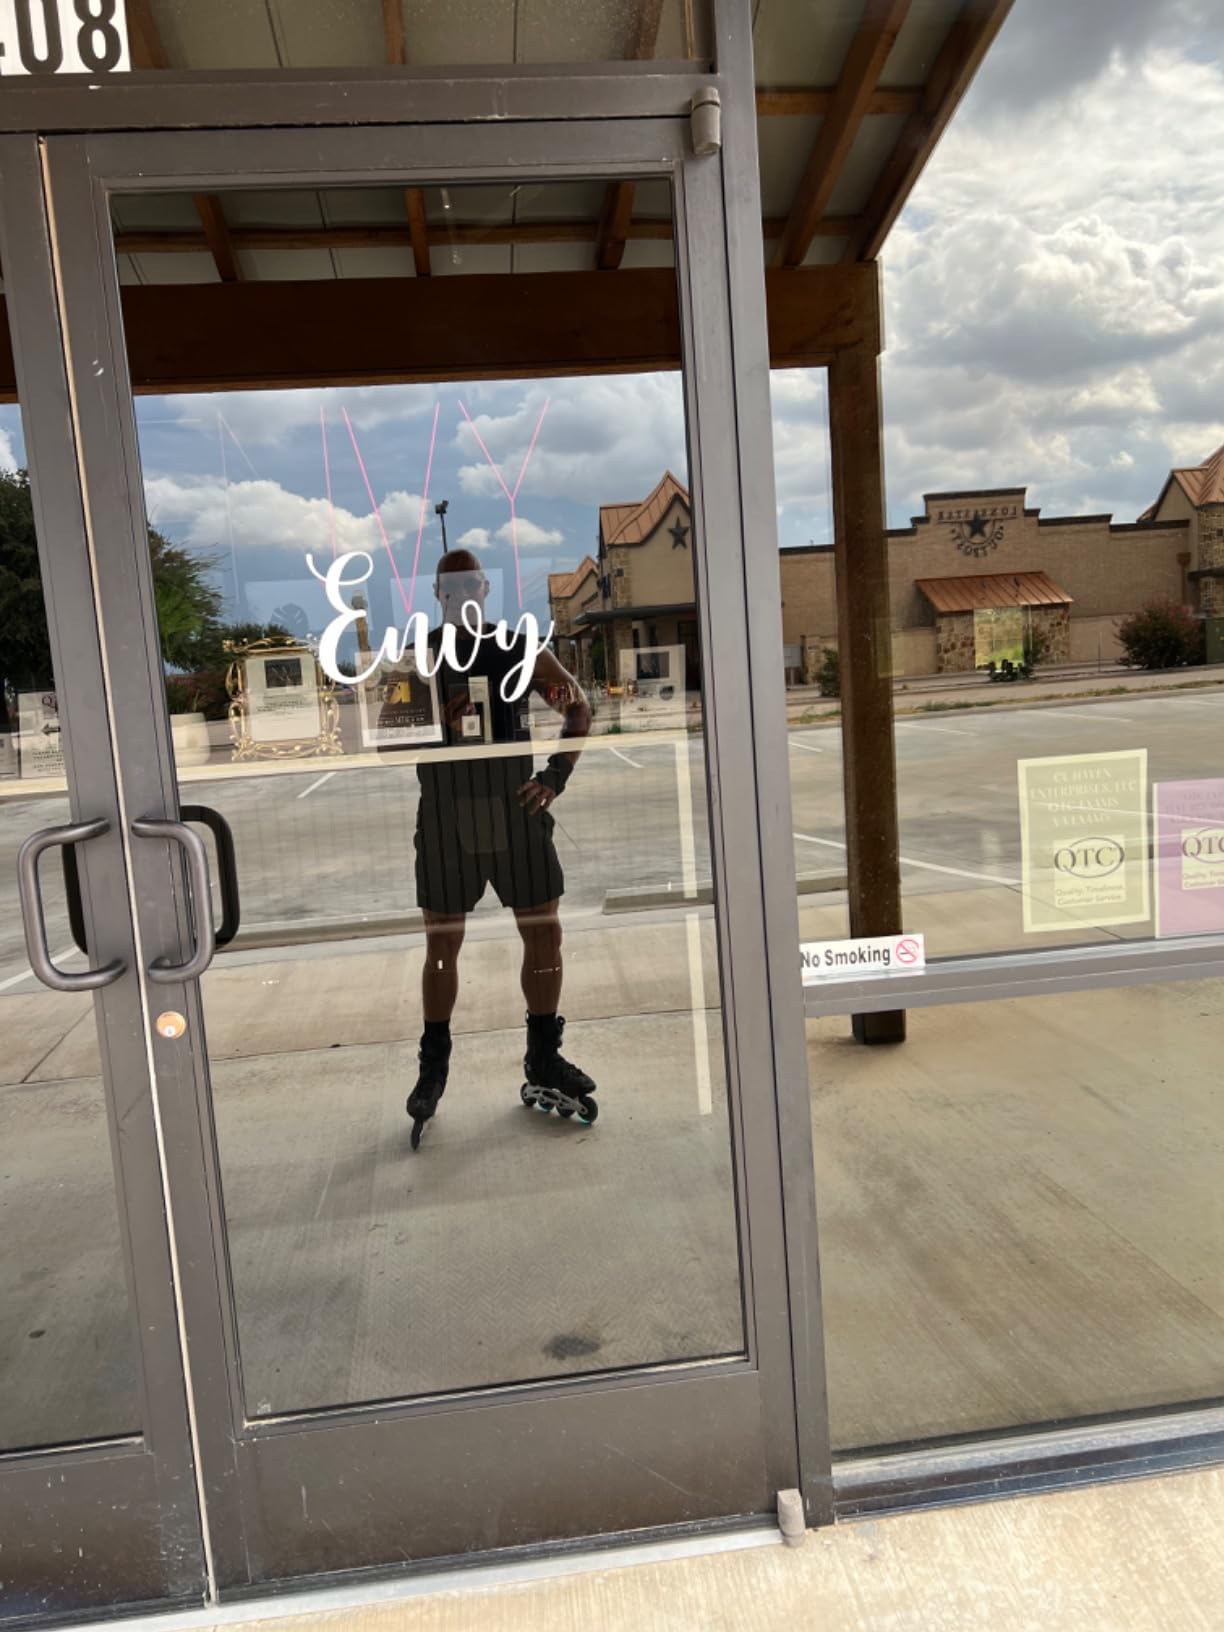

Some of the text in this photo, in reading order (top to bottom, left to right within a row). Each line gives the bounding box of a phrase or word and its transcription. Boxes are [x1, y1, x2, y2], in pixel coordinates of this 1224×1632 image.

[0, 0, 122, 74] 08
[305, 551, 556, 703] Envy
[1054, 846, 1116, 873] QTC
[799, 946, 891, 968] No Smoking
